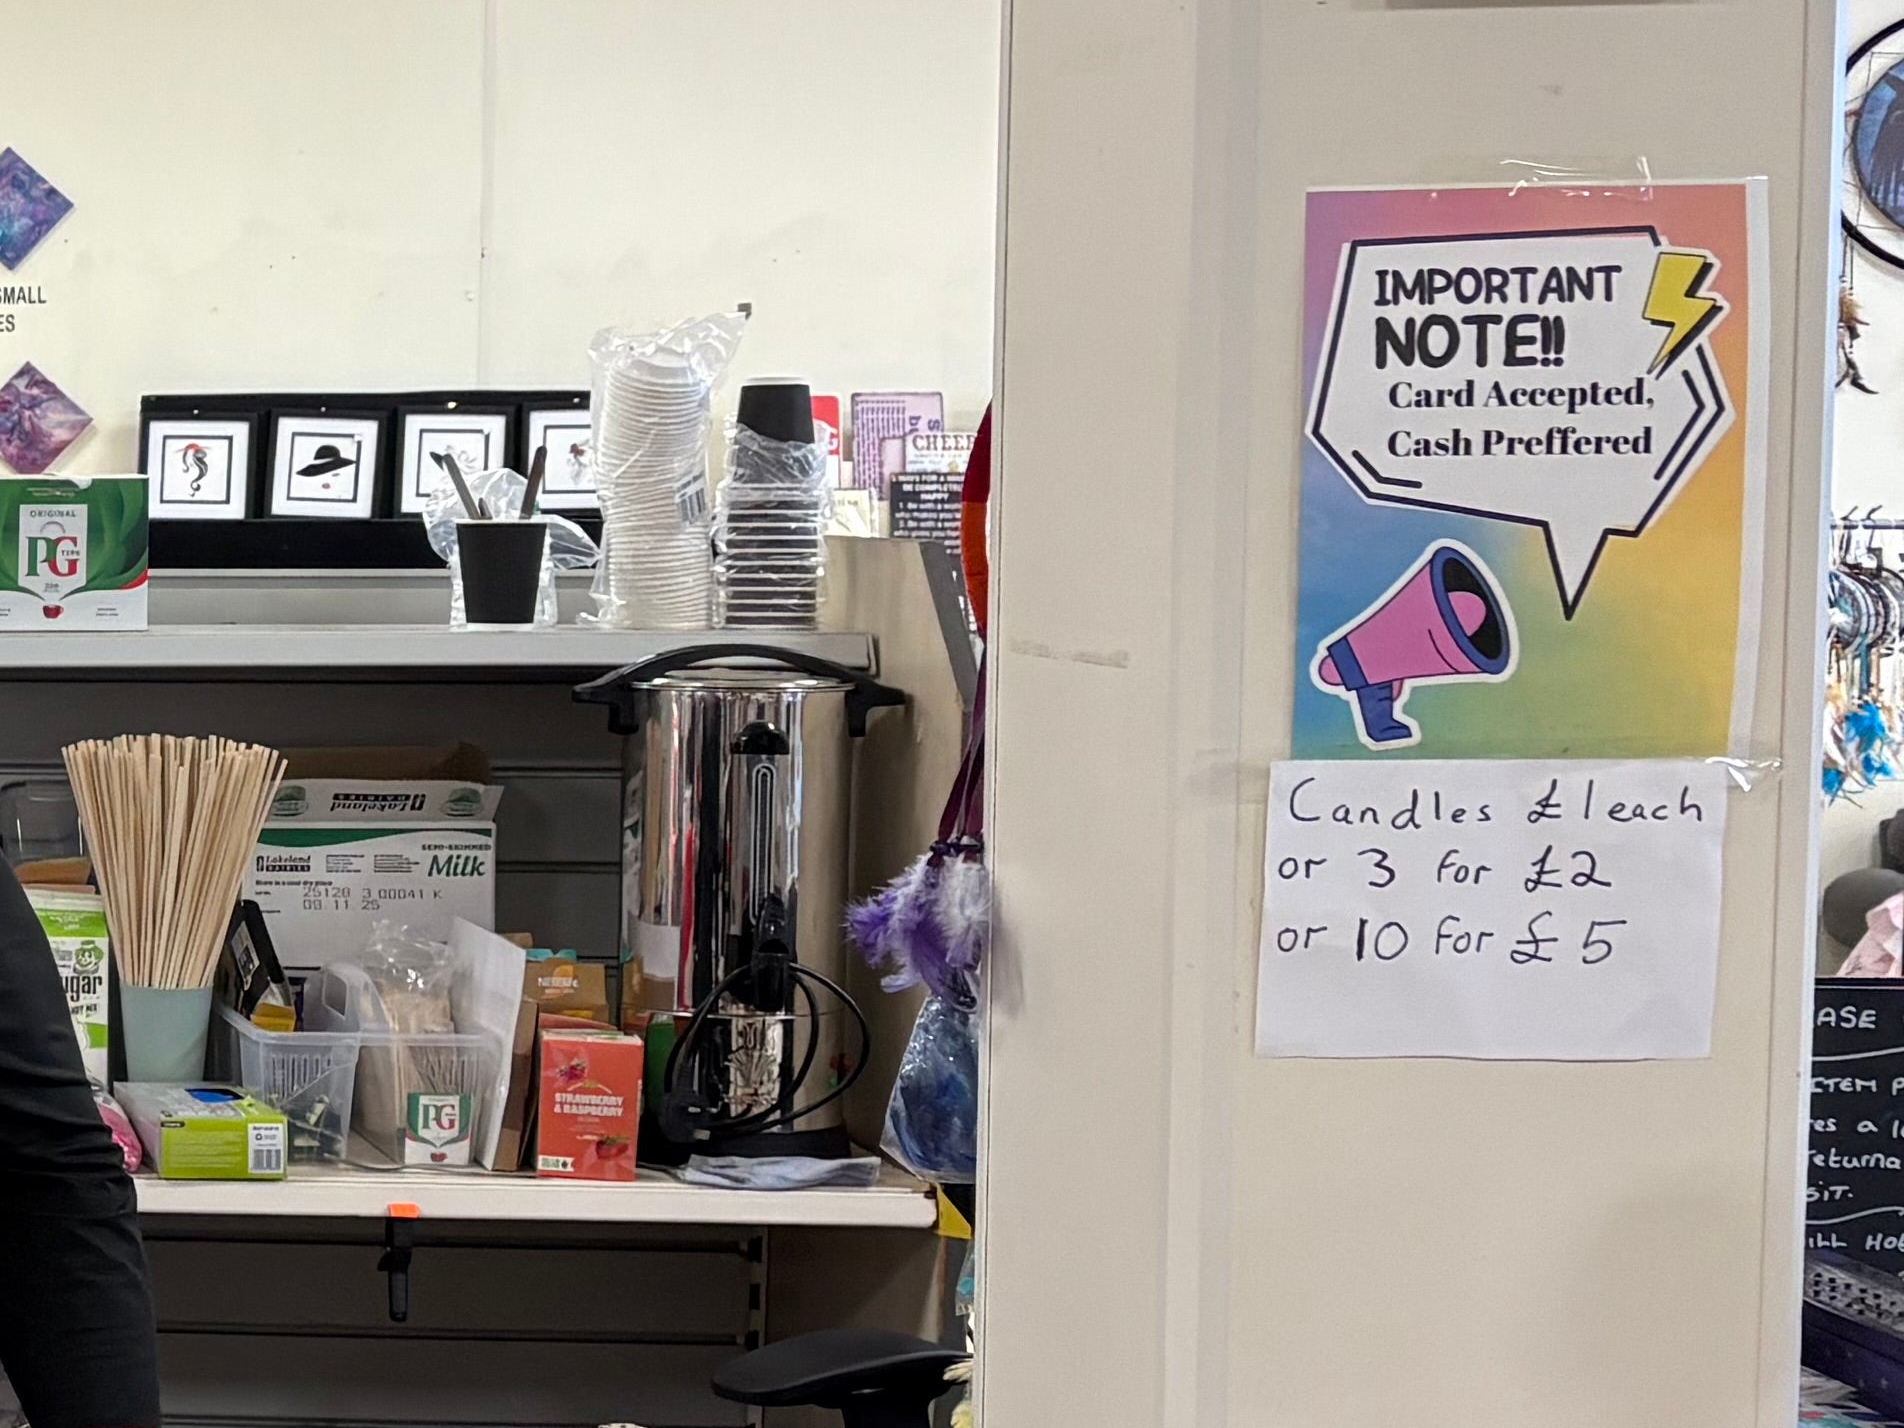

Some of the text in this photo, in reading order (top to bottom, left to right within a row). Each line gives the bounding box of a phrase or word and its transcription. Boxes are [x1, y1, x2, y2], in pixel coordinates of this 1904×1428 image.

[1374, 264, 1622, 306] IMPORTANT
[1374, 314, 1566, 369] NOTE!!
[1389, 376, 1655, 414] Card Accepted,
[1387, 425, 1653, 458] Cash Preffered
[25, 535, 80, 578] PG
[1290, 776, 1704, 831] Candles £1 each
[428, 854, 486, 878] Milk
[1278, 855, 1328, 880] or
[1357, 848, 1396, 888] 3
[1524, 844, 1612, 893] £2
[1277, 925, 1328, 953] or
[1356, 917, 1409, 962] 10
[421, 1104, 456, 1131] PG
[554, 1092, 624, 1107] STRAWBERRY
